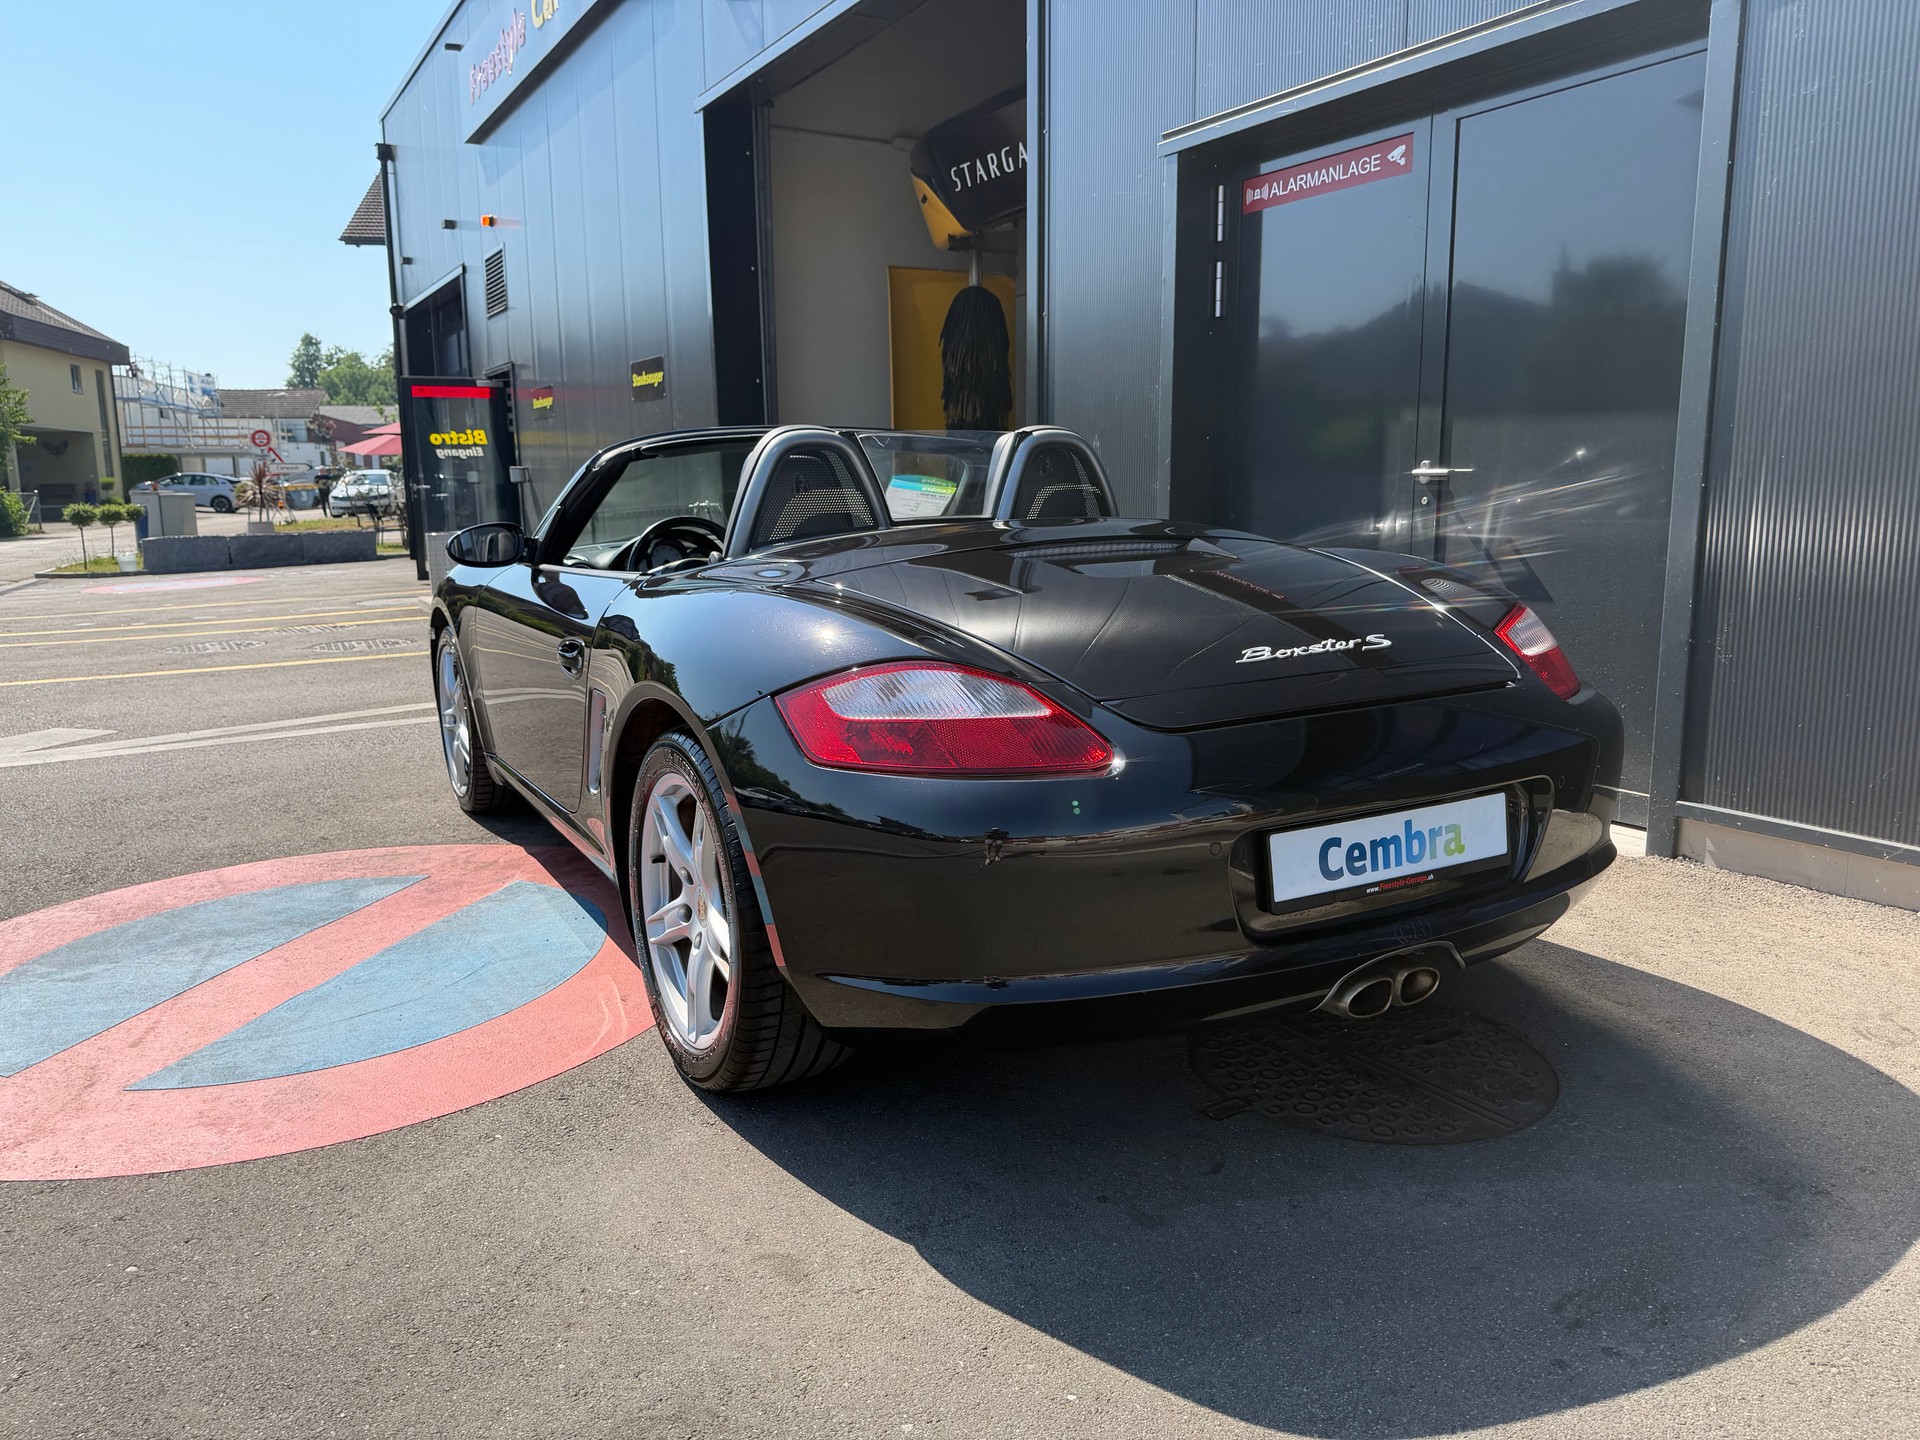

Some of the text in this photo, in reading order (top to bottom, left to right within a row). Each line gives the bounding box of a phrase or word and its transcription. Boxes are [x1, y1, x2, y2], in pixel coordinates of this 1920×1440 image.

[469, 7, 526, 106] Freestyle
[951, 141, 1027, 192] STARGA
[1269, 154, 1382, 198] ALARMANLAGE
[1235, 633, 1393, 664] Boxster S
[1318, 818, 1466, 881] Cembra
